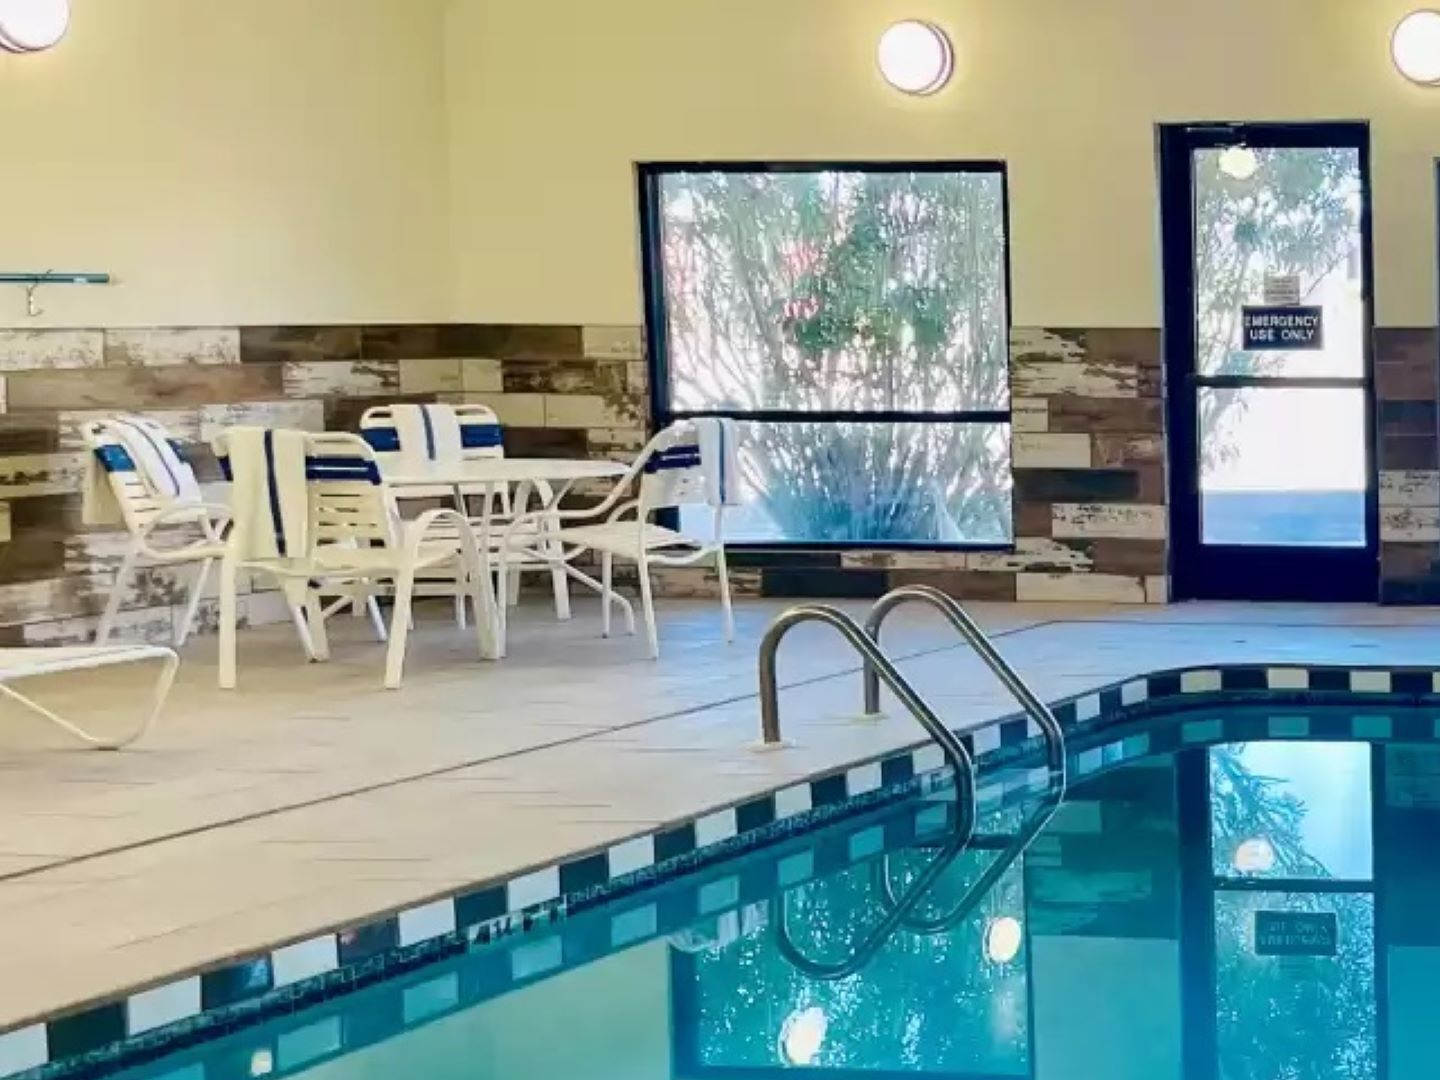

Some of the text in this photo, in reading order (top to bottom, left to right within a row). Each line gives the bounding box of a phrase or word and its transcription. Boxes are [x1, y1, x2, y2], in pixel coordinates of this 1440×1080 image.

[1244, 315, 1318, 327] EMERGENCY
[1249, 329, 1315, 340] USE ONLY
